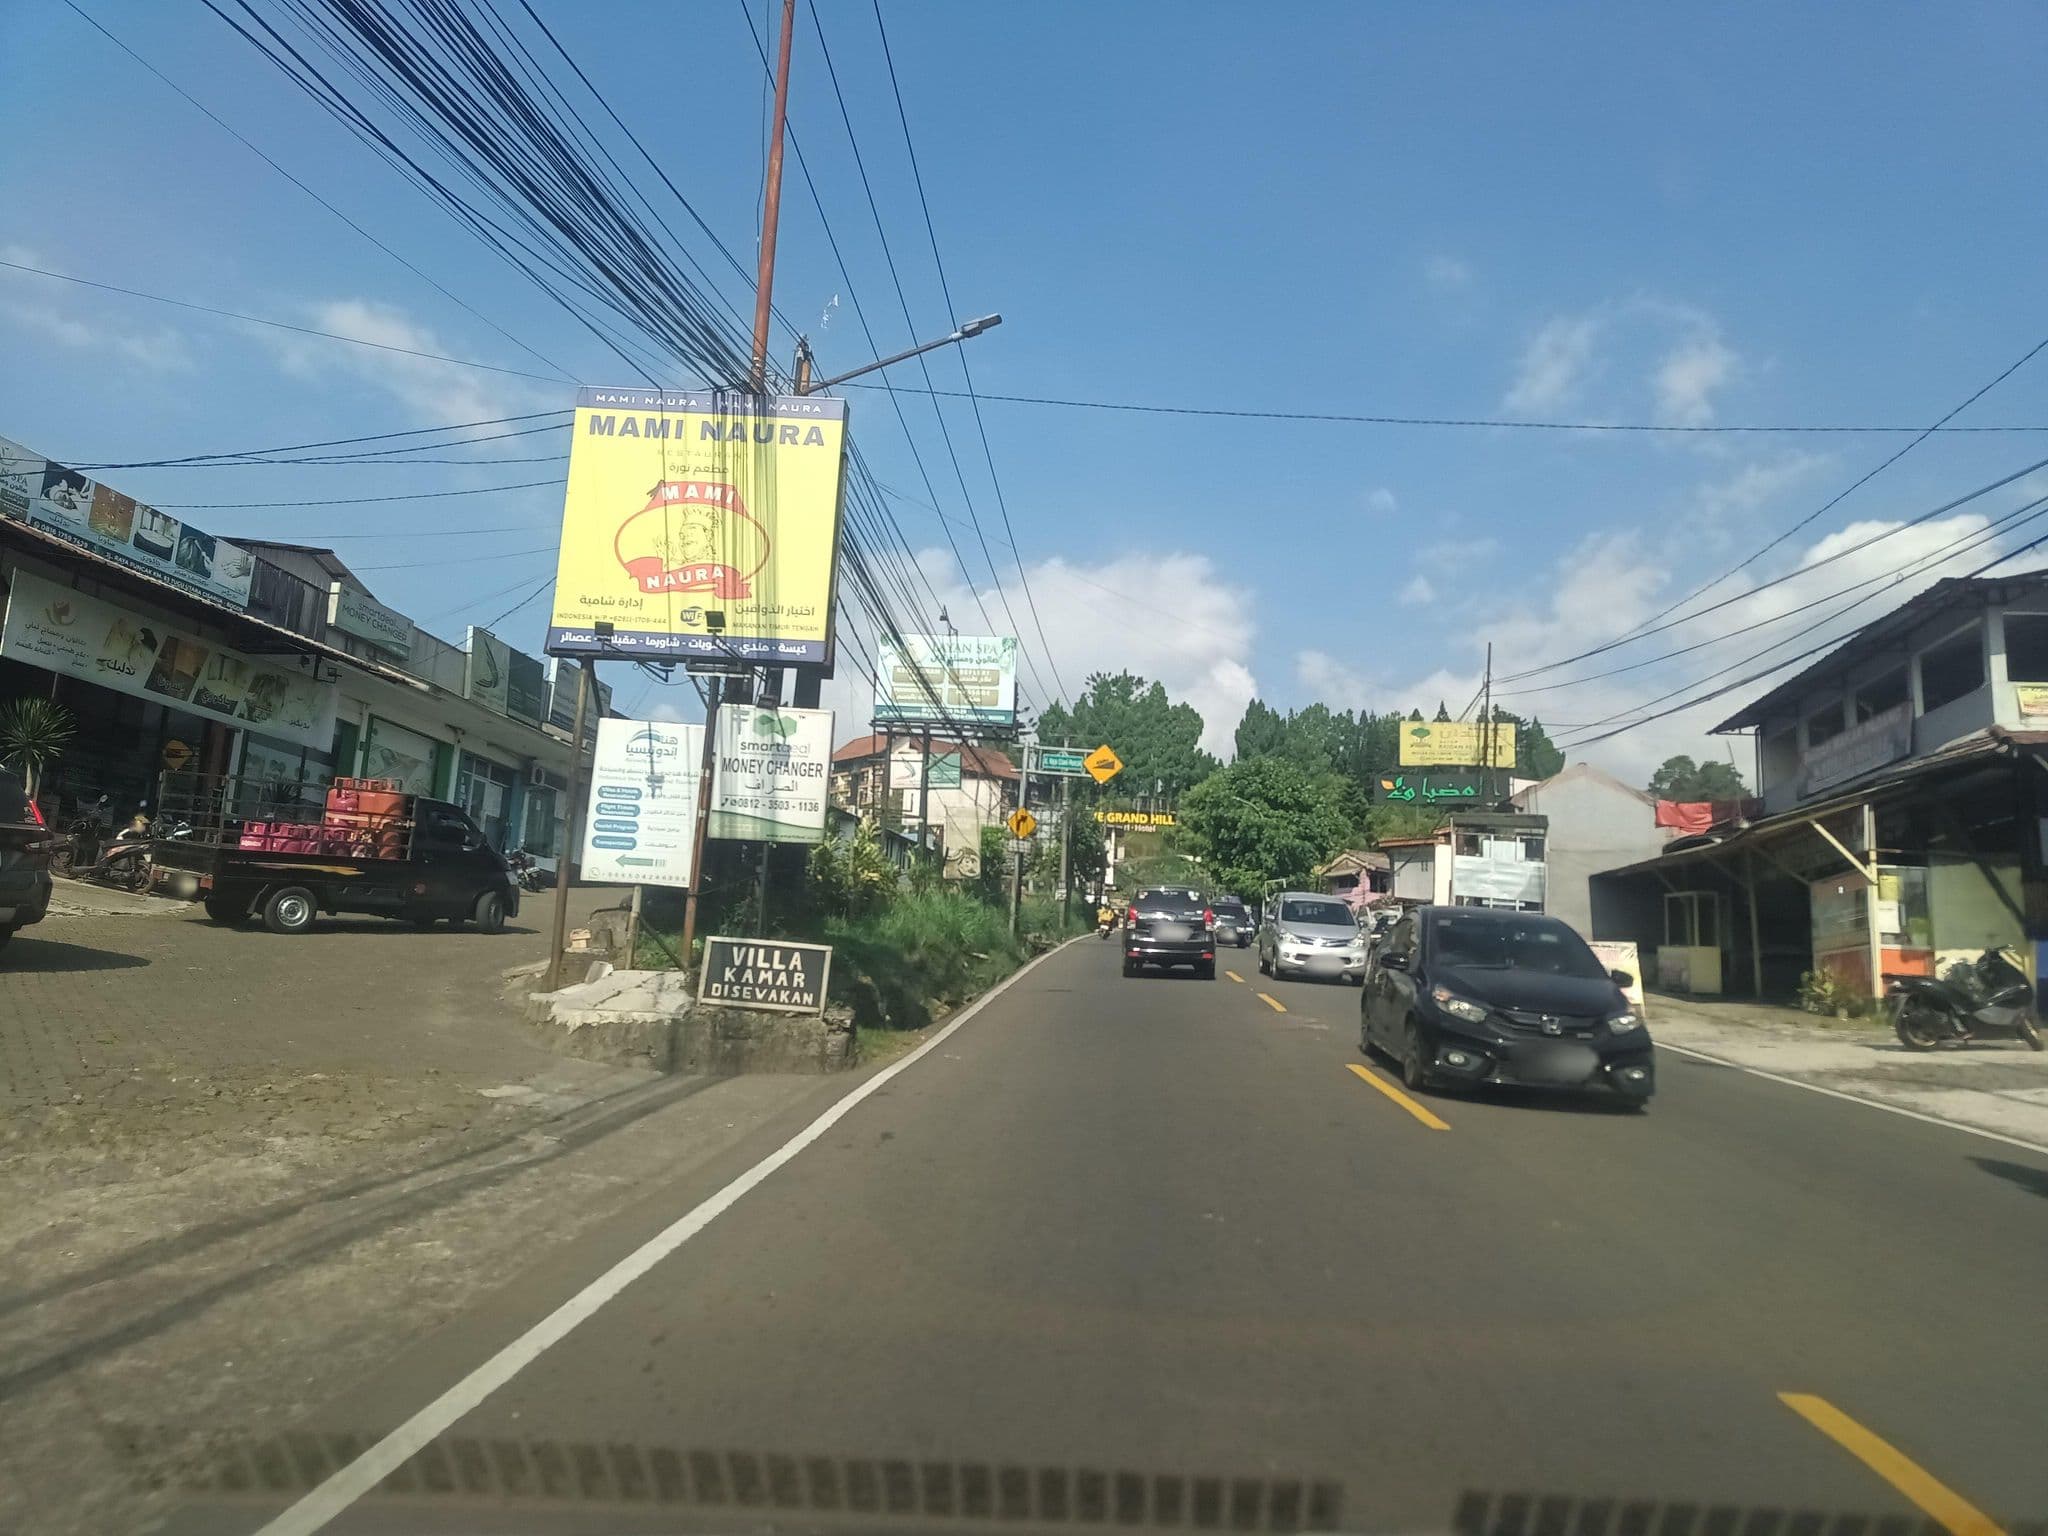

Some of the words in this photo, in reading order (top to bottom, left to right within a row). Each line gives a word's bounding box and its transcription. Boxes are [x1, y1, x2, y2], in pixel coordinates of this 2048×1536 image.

[595, 393, 636, 404] MAMI
[644, 398, 699, 407] NAURA
[768, 404, 823, 414] NAURA
[588, 415, 684, 440] MAMI
[699, 420, 825, 447] NAURA
[669, 462, 691, 475] نورة
[692, 464, 729, 476] مطعم
[660, 483, 735, 505] MAMI
[646, 566, 726, 589] NAURA
[619, 598, 644, 611] إدارة
[341, 604, 371, 625] MONEY
[372, 619, 408, 641] CHANGER
[559, 631, 593, 644] عصائر
[645, 635, 681, 650] شاورما
[738, 641, 770, 653] مندي
[721, 757, 764, 775] MONEY
[766, 760, 824, 779] CHANGER
[767, 799, 791, 811] 3503
[798, 801, 820, 812] 1136
[1106, 812, 1149, 824] GRAND
[1150, 814, 1176, 826] HILL
[731, 945, 803, 971] VILLA
[723, 967, 806, 989] KAMAR
